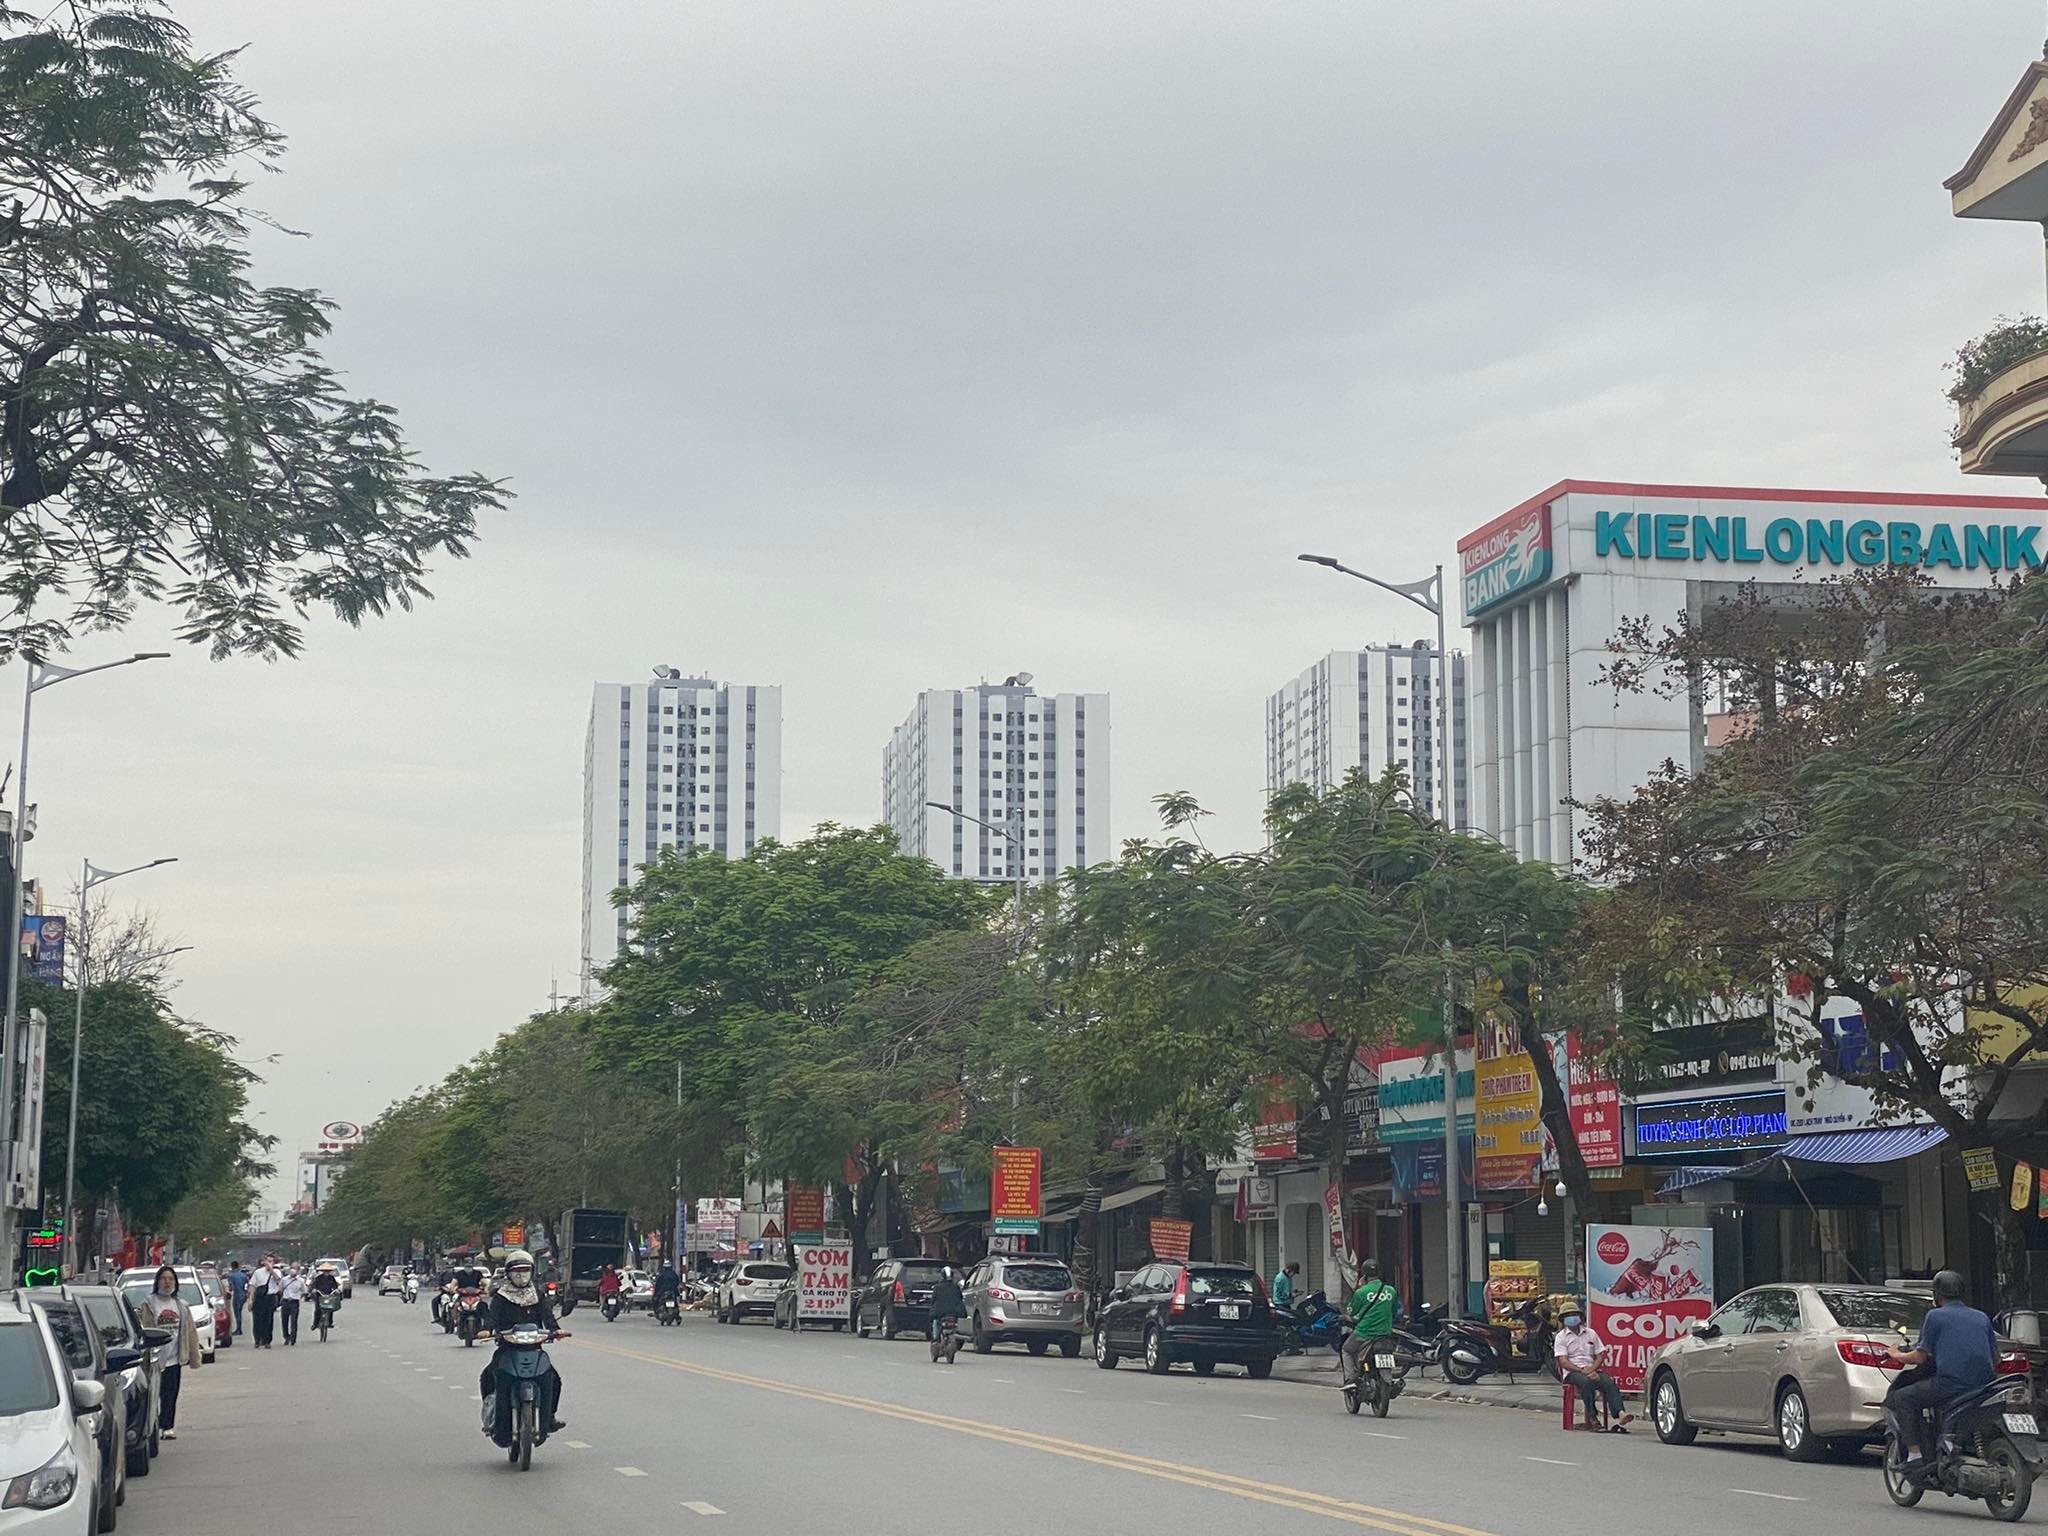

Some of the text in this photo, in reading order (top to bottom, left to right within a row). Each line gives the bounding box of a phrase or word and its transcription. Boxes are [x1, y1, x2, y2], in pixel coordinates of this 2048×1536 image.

[1466, 528, 1510, 570] KIENLONG
[1595, 510, 2042, 570] KIENLONGBANK
[1466, 559, 1511, 612] BANK
[804, 1248, 849, 1267] CƠM
[803, 1267, 849, 1289] TÁM
[1606, 1309, 1697, 1339] CƠM
[1601, 1344, 1656, 1373] 37 LẠC
